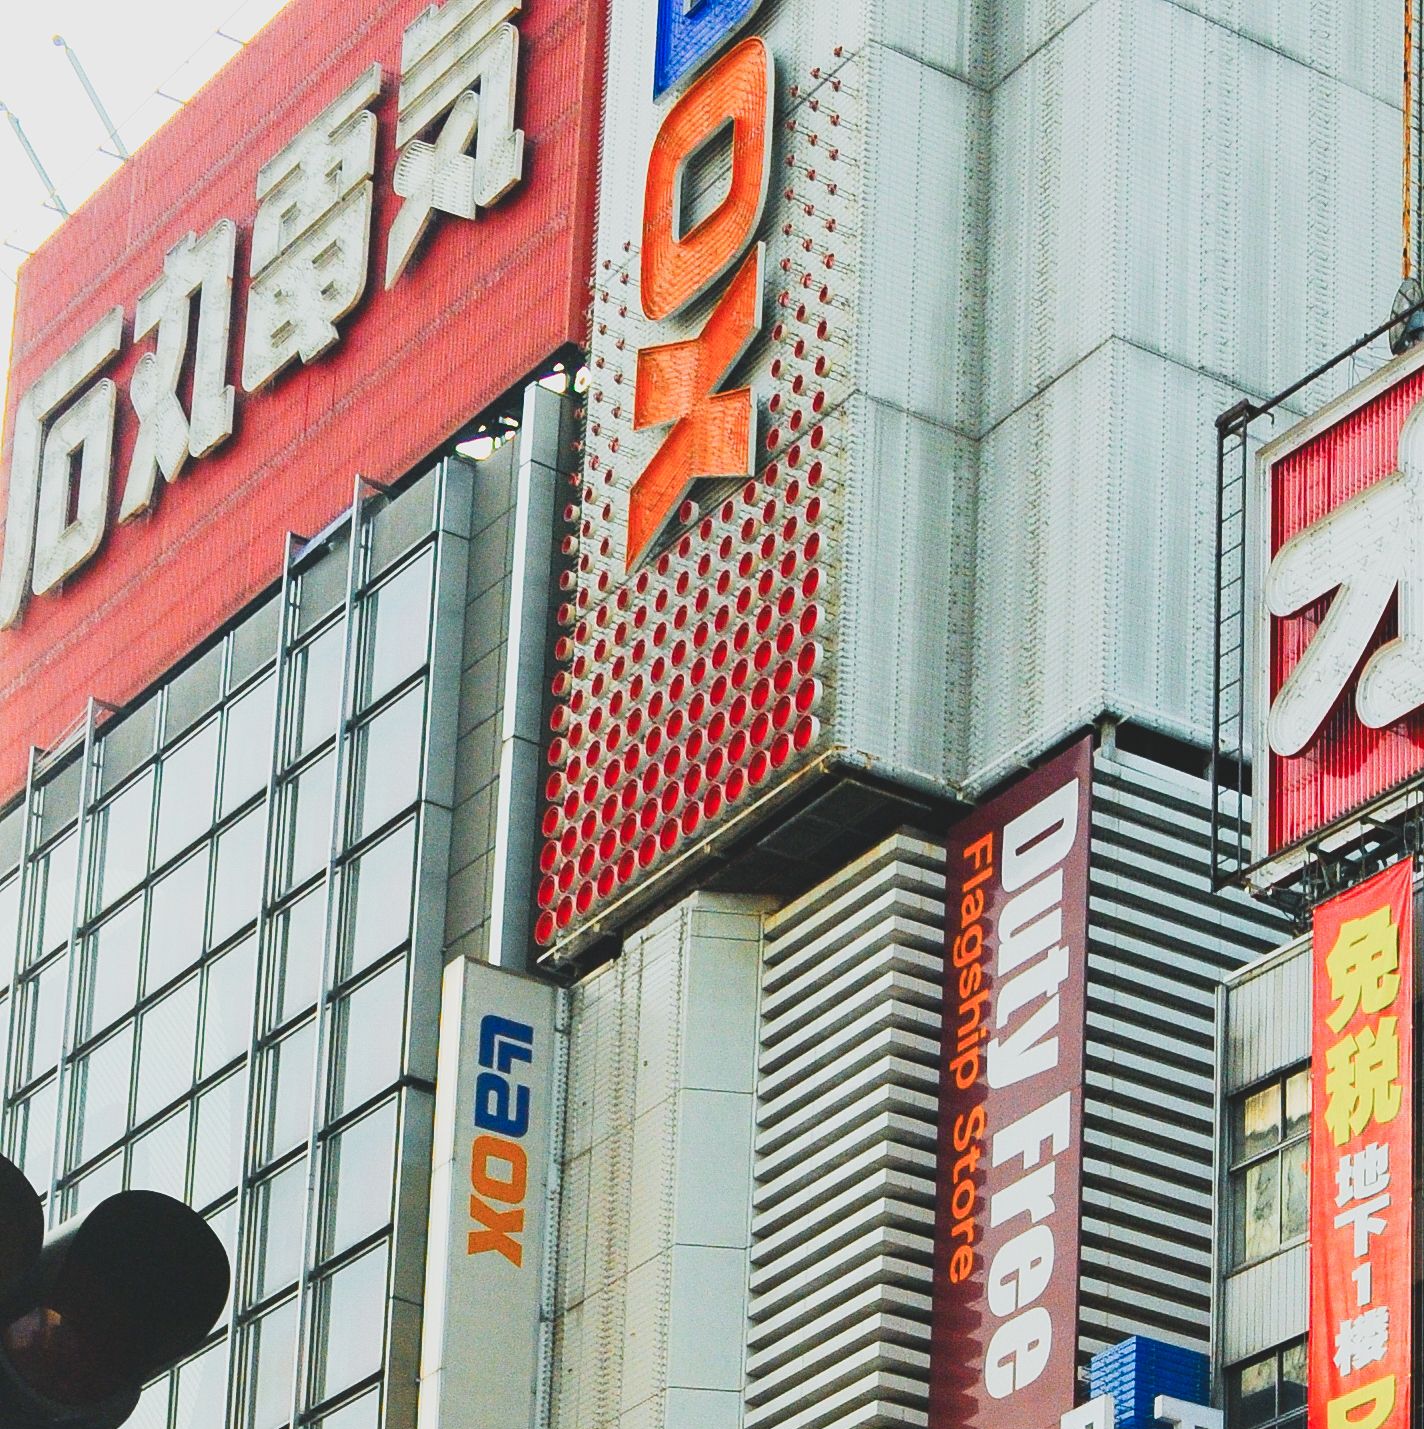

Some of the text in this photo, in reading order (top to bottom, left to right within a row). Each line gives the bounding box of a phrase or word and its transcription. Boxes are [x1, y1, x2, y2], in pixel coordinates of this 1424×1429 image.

[950, 830, 995, 1285] Flagship Store
[984, 776, 1080, 1400] Duty Free
[1325, 904, 1402, 1146] 免税
